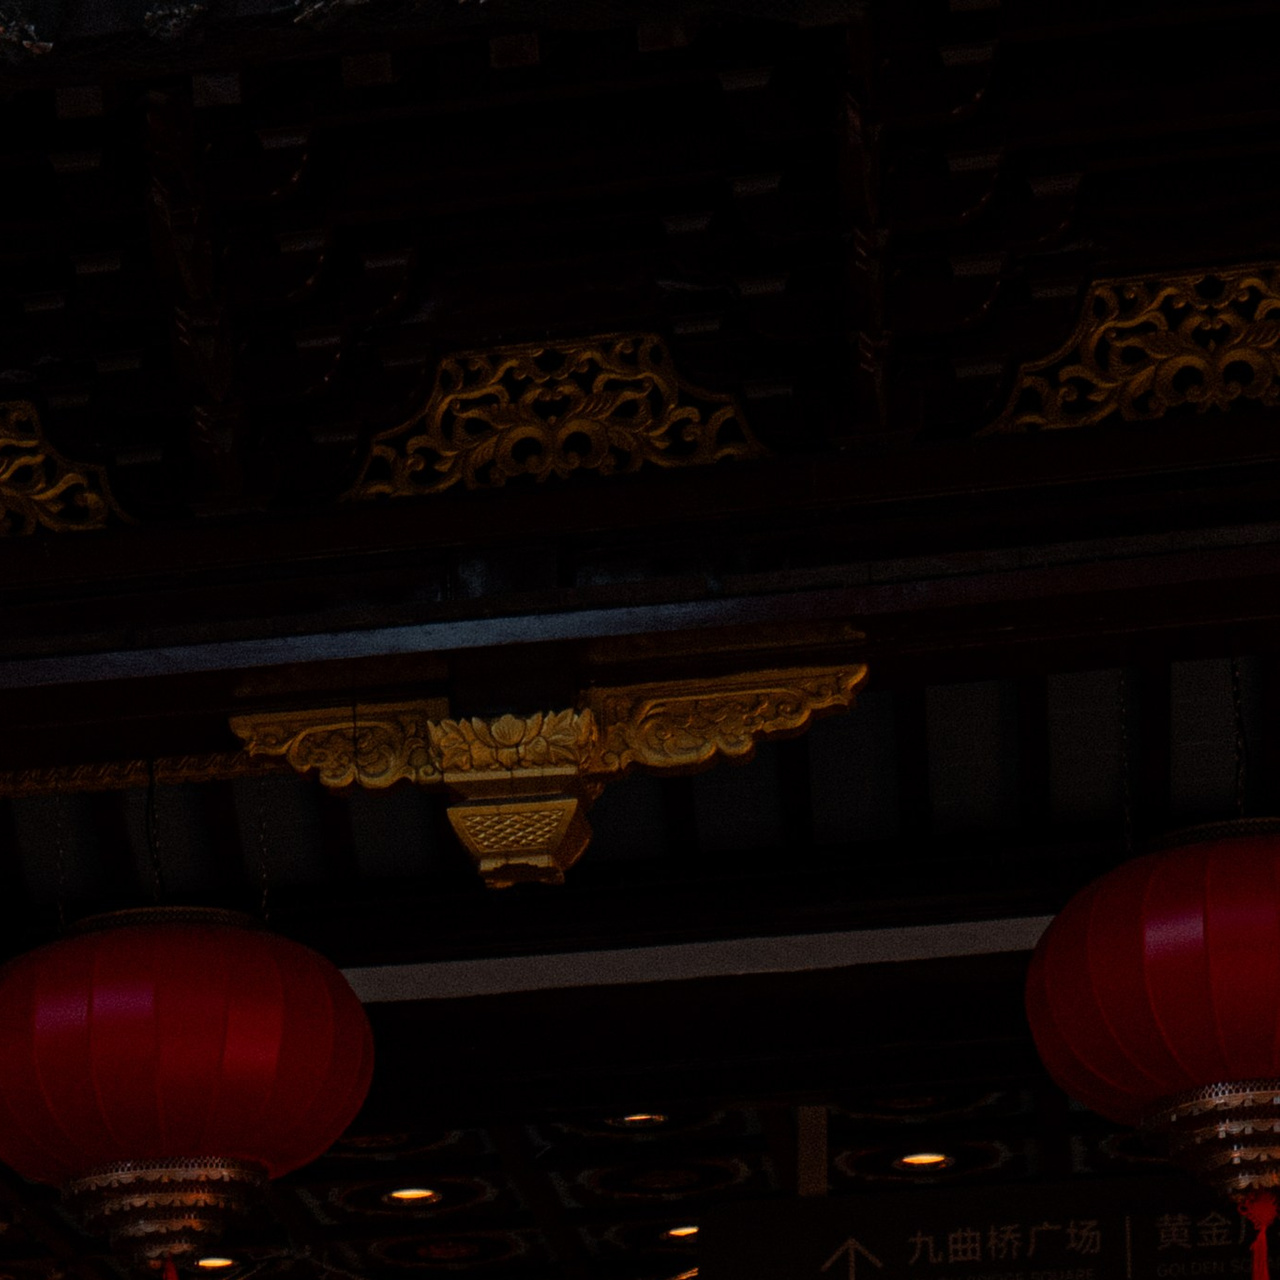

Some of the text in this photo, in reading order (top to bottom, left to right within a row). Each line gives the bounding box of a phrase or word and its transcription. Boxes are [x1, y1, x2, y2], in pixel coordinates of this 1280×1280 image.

[908, 1218, 1102, 1265] 九曲桥广场
[1156, 1261, 1226, 1278] GOLDEN
